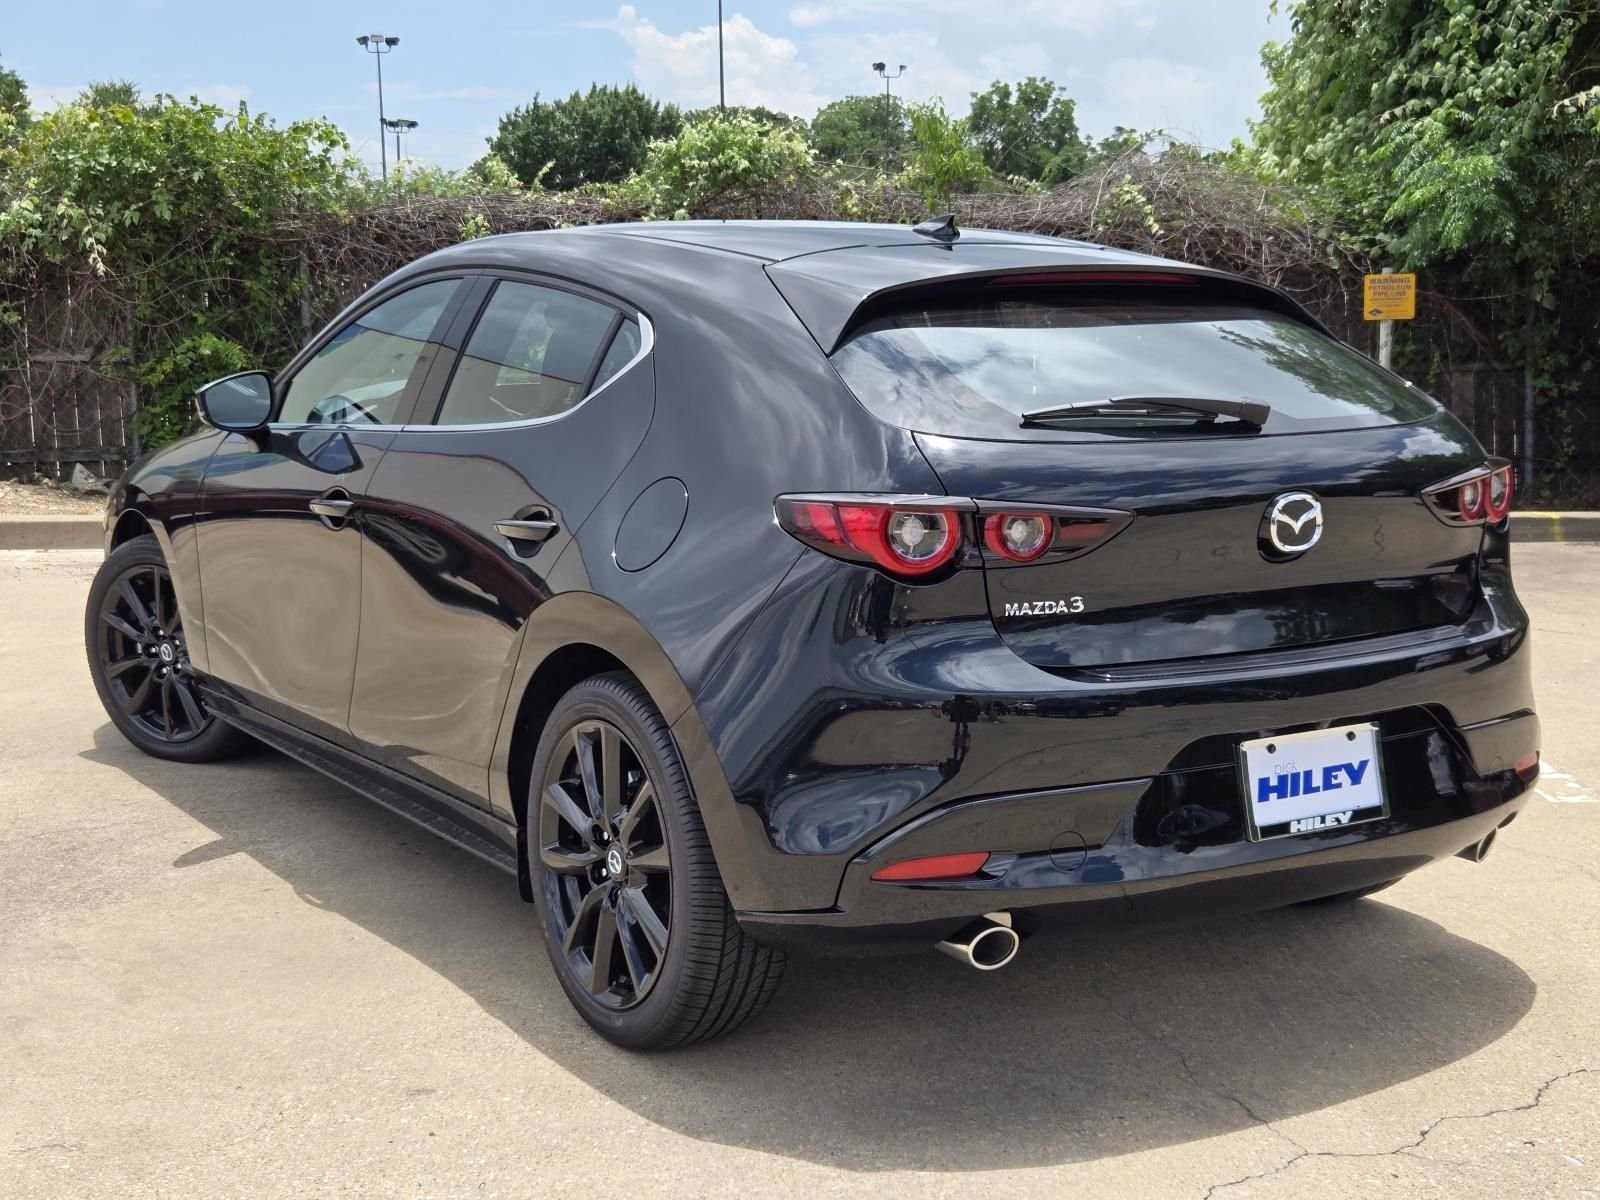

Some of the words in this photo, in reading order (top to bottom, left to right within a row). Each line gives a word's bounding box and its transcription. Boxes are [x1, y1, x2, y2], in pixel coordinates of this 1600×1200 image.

[1369, 277, 1410, 285] WARNING
[1257, 759, 1370, 803] HILEY
[1290, 810, 1353, 833] HILEY
